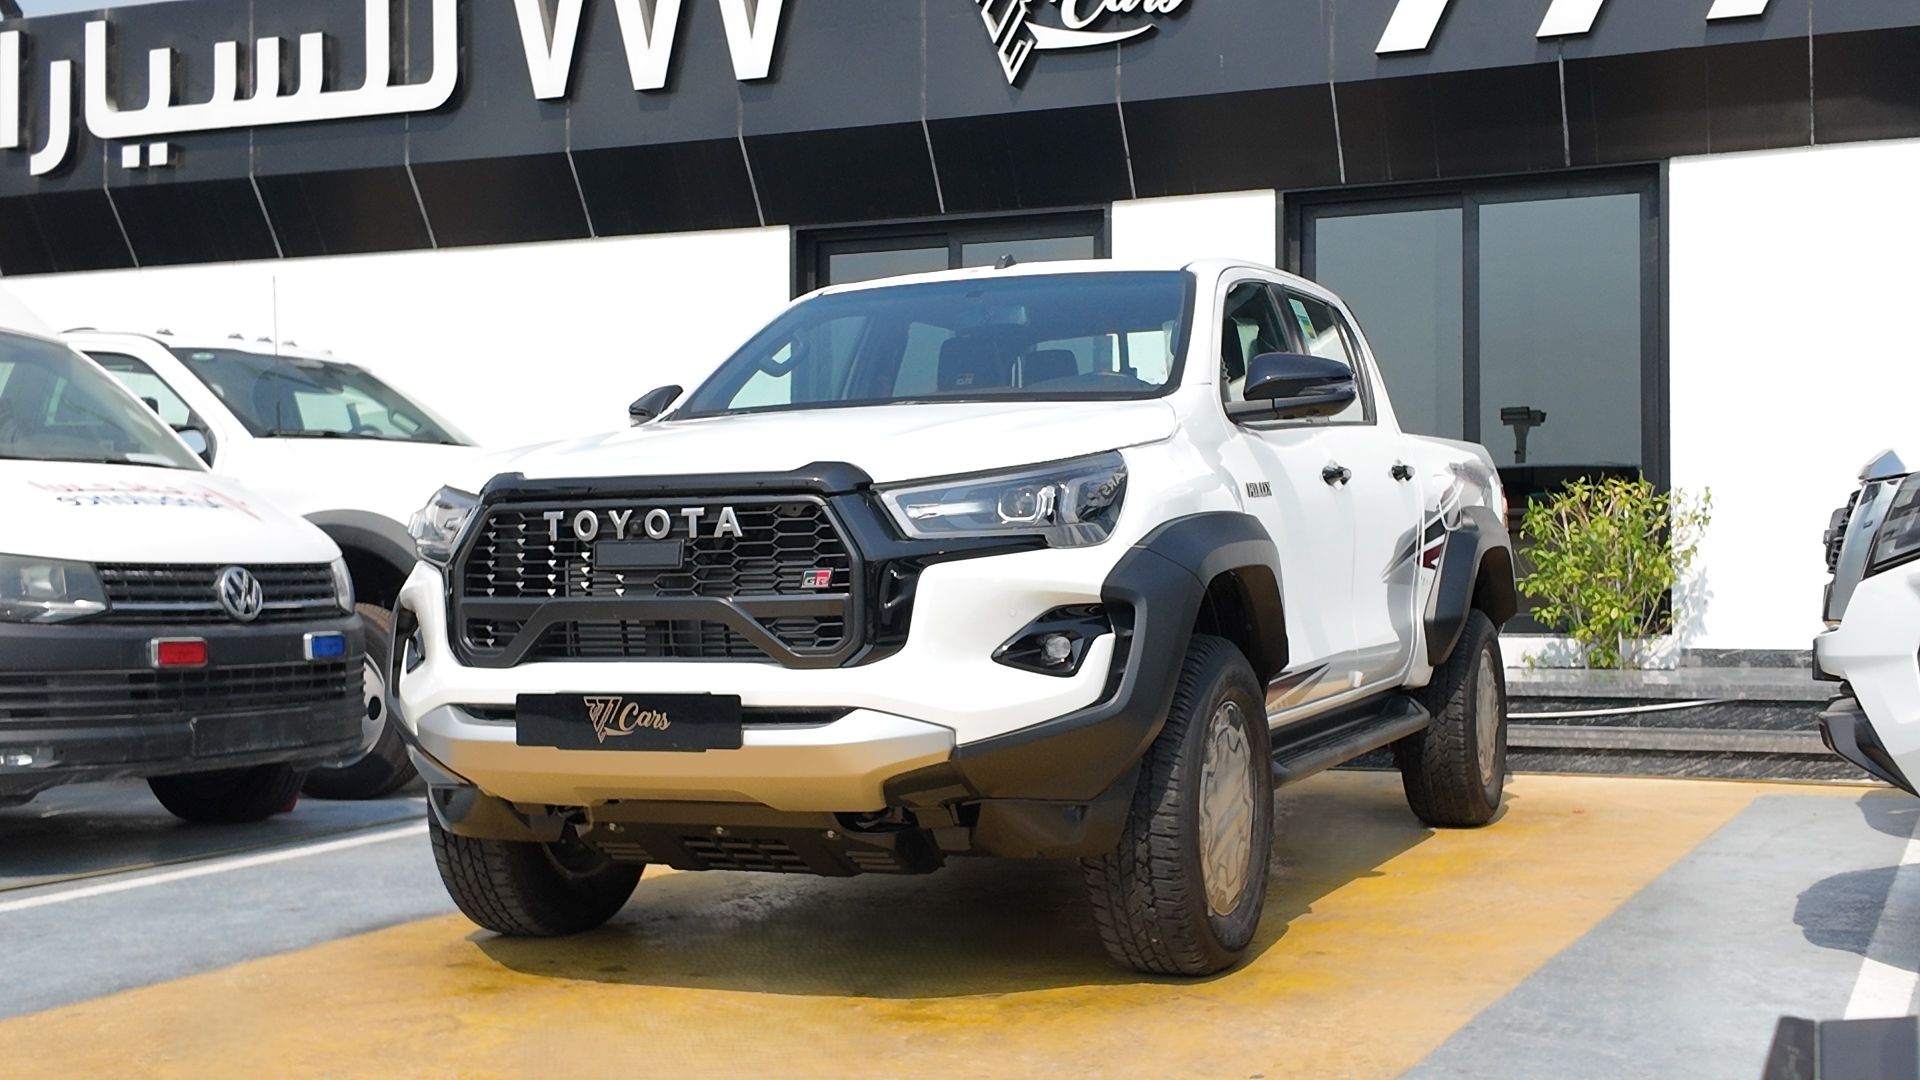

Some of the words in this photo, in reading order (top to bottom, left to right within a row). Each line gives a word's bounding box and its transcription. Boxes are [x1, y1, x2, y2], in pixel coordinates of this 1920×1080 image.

[0, 0, 458, 176] للسيارا
[543, 506, 744, 542] TOYOTA
[618, 702, 671, 731] Cars
